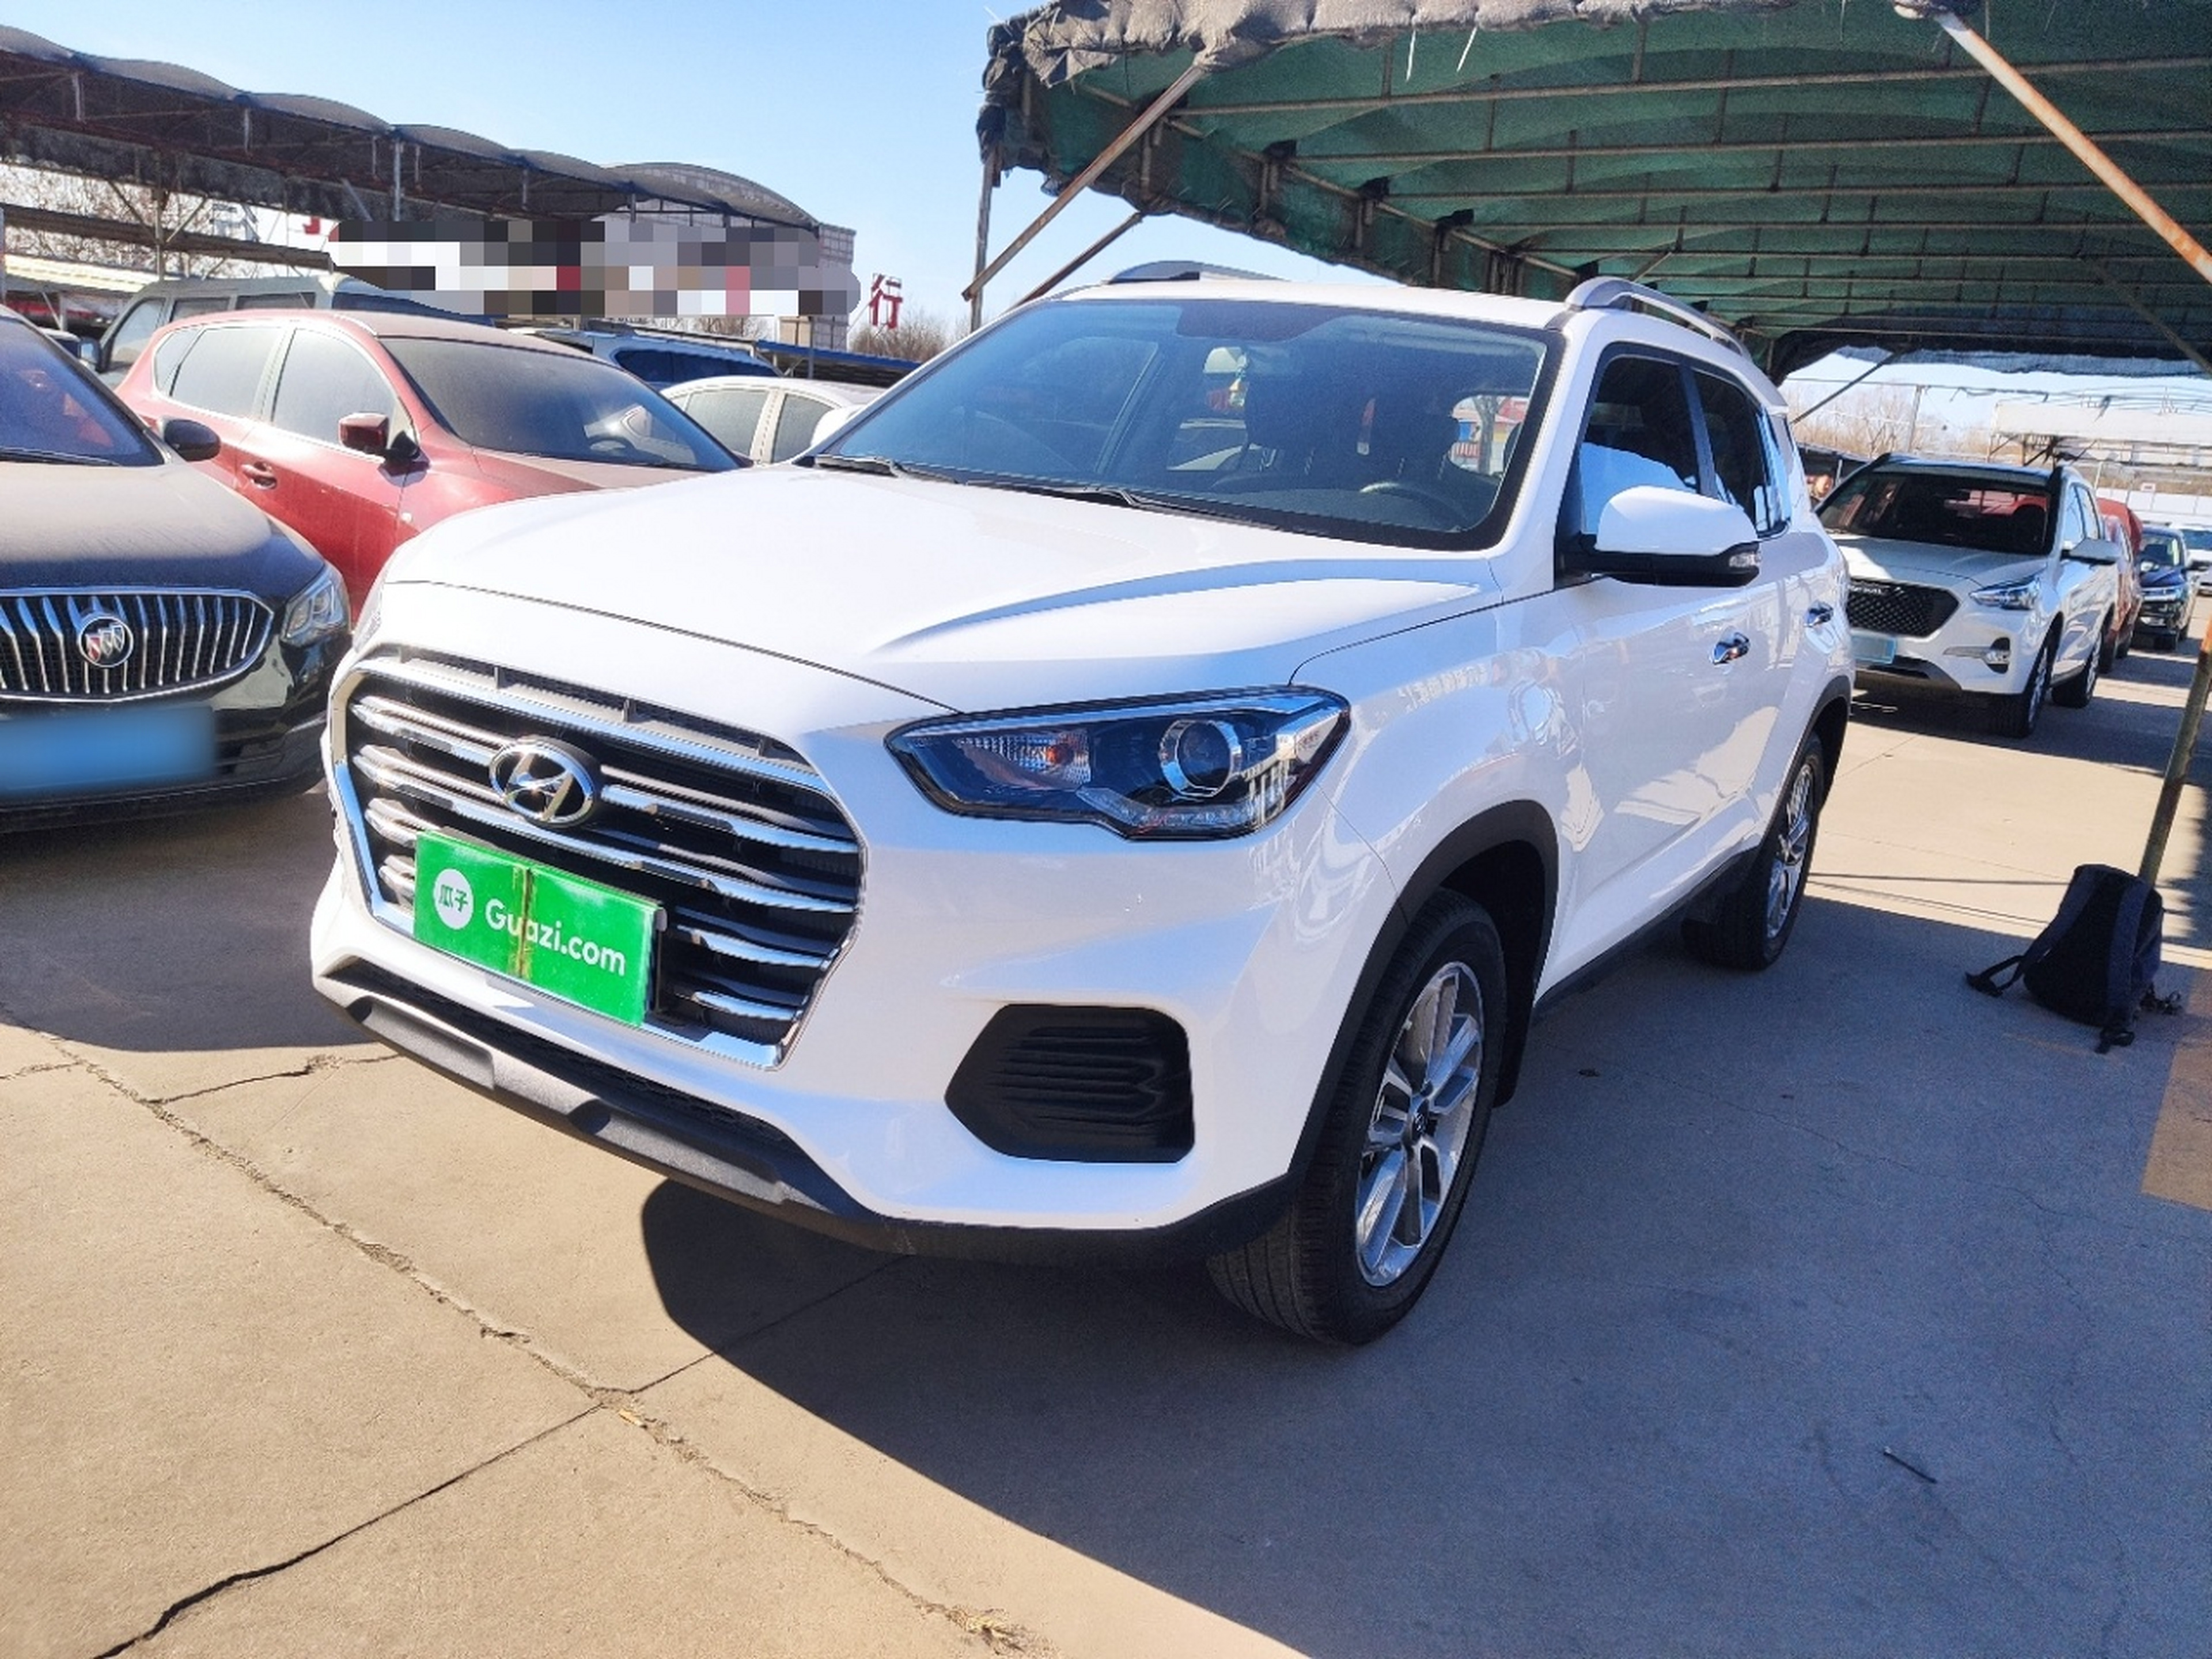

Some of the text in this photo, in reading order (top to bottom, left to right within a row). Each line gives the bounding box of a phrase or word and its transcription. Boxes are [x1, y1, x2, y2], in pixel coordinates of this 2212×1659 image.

[869, 274, 903, 329] 行
[438, 884, 468, 912] 瓜子
[485, 898, 626, 977] Guazi.com
